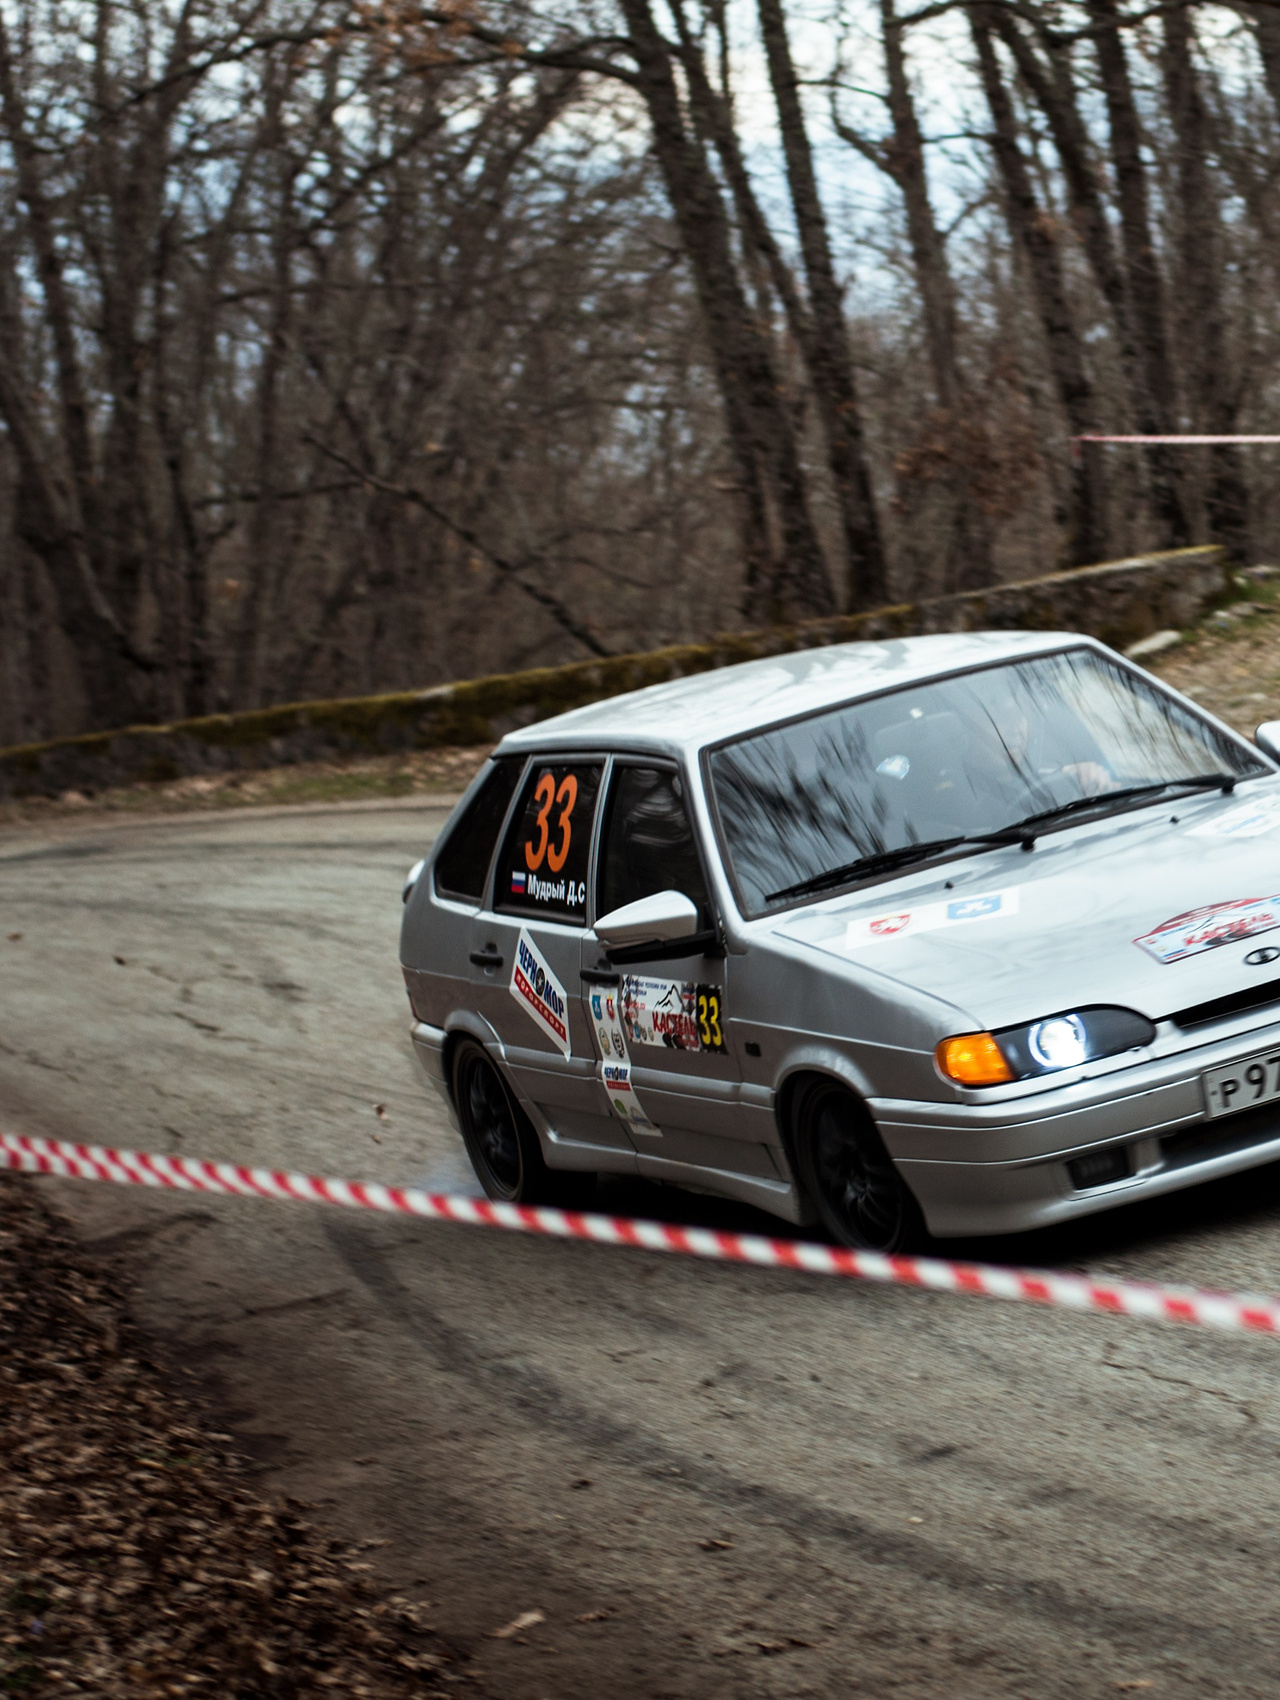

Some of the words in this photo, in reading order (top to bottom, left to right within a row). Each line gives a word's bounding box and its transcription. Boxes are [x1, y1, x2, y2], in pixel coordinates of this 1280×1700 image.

[525, 773, 578, 873] 33
[527, 874, 566, 902] Мудрый
[698, 994, 722, 1046] 33
